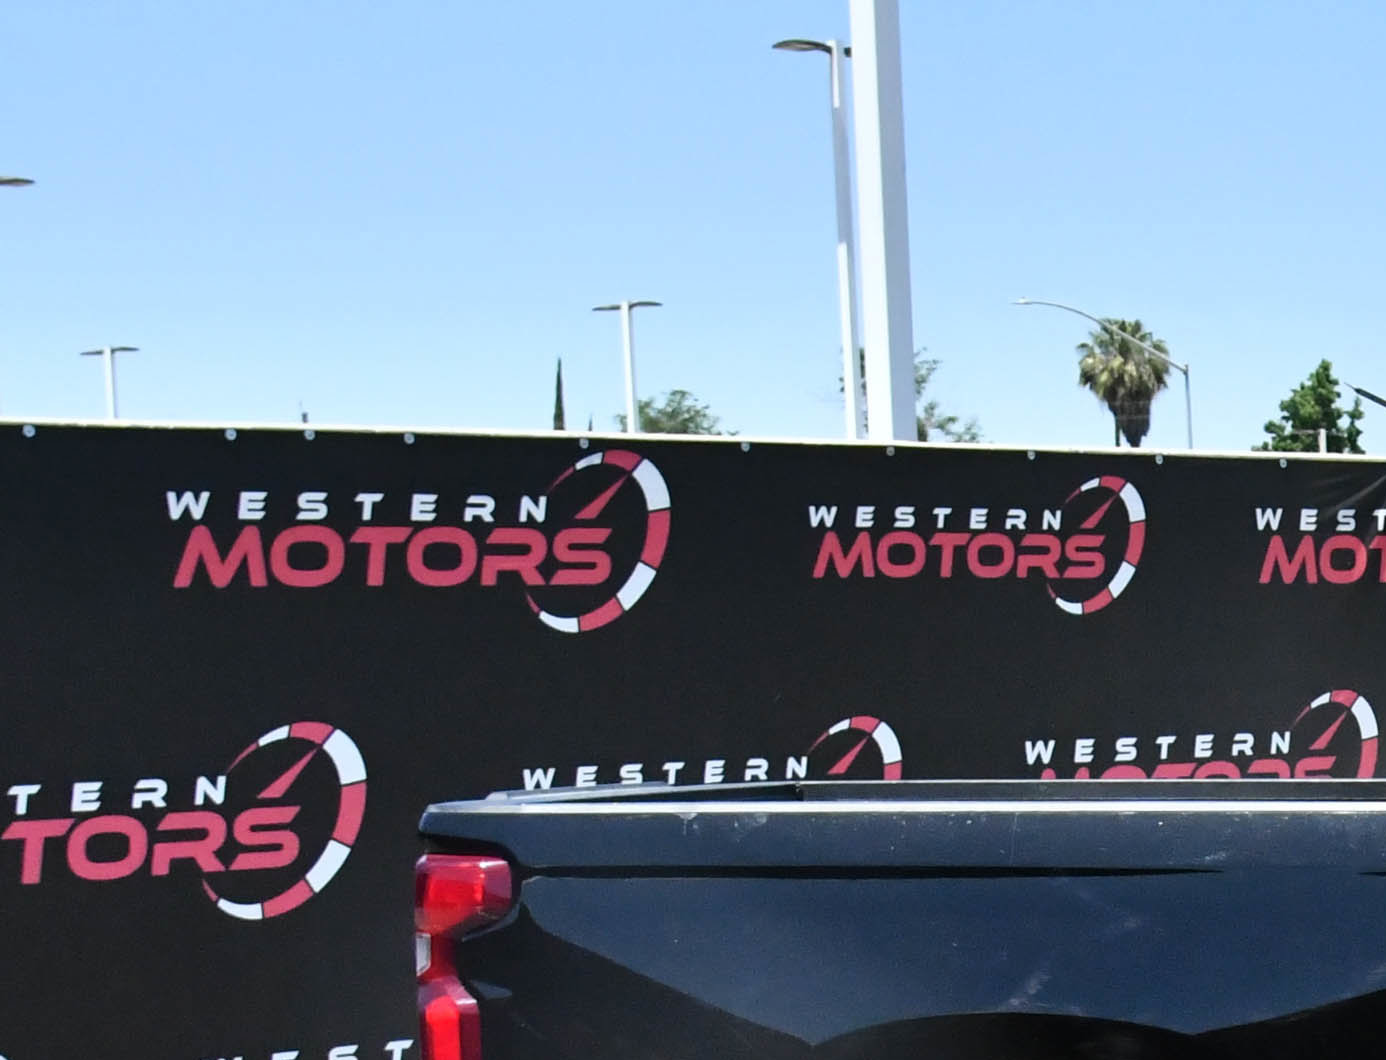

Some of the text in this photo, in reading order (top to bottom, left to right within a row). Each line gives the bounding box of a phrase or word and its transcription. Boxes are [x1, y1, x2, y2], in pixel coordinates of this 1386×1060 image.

[166, 491, 548, 521] WESTERN
[808, 505, 1062, 531] WESTERN
[173, 525, 612, 588] MOTORS
[813, 531, 1105, 579] MOTORS
[1024, 730, 1291, 766] WESTERN
[522, 755, 808, 791] WESTERN
[7, 775, 227, 815] TERN
[1, 805, 301, 885] TORS
